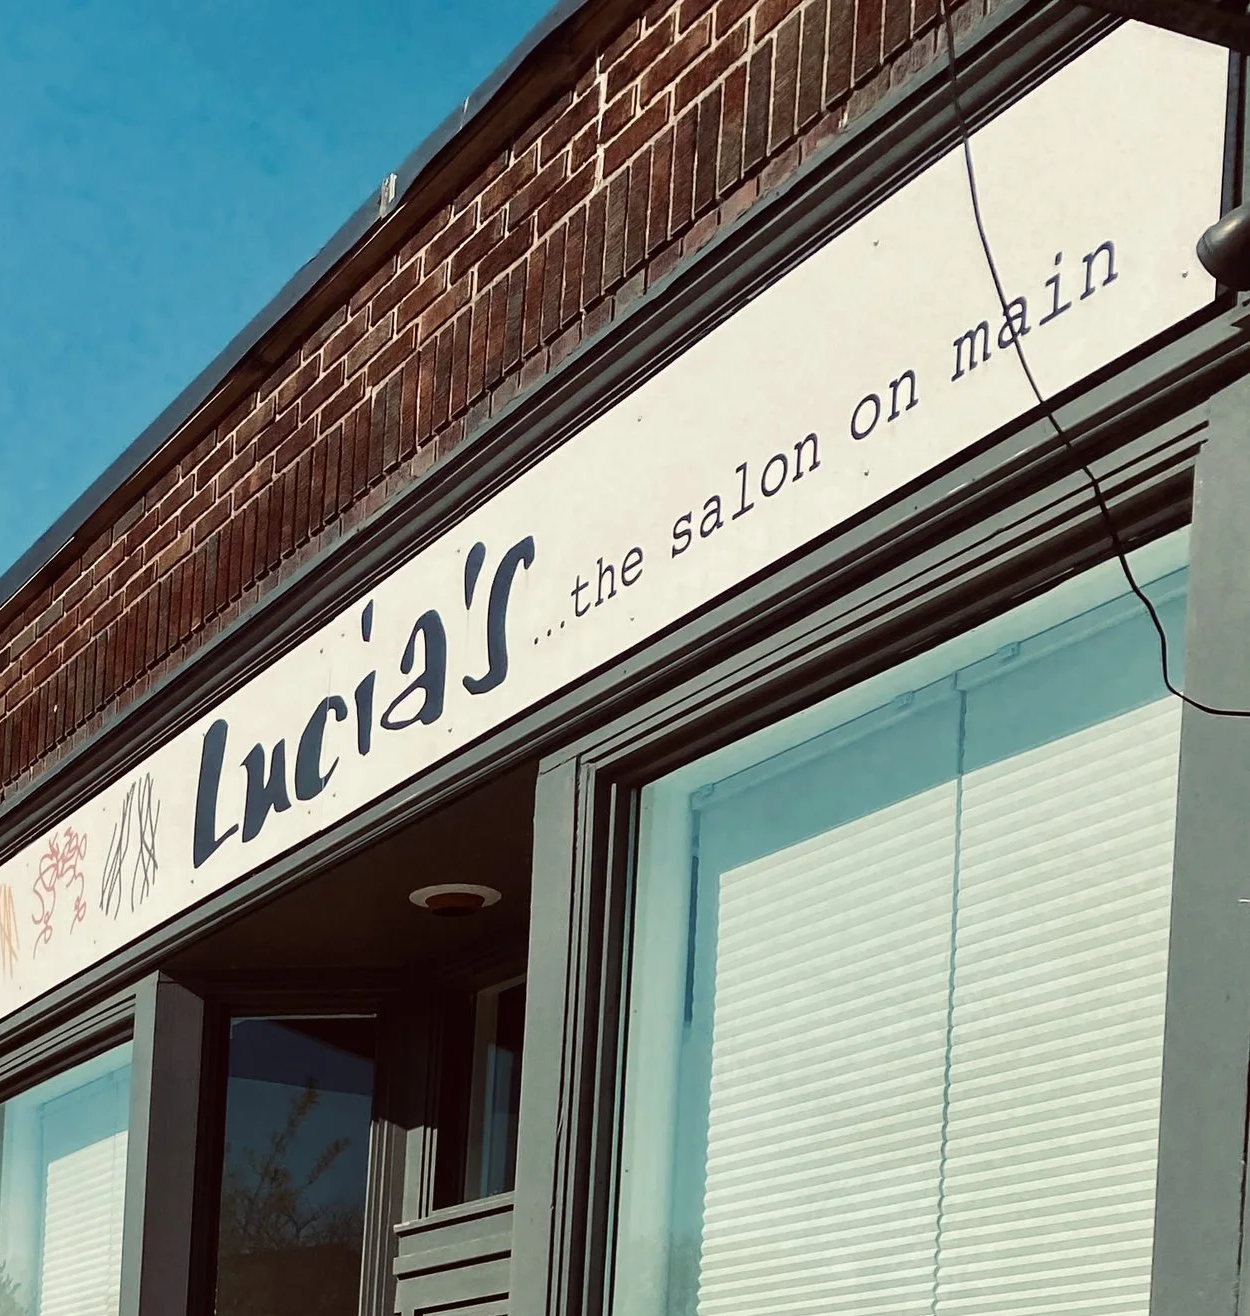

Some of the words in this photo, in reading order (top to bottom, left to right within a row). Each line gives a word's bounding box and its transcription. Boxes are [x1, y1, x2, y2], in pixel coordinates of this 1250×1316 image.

[670, 434, 821, 559] salon
[849, 367, 918, 441] on
[950, 238, 1118, 382] main
